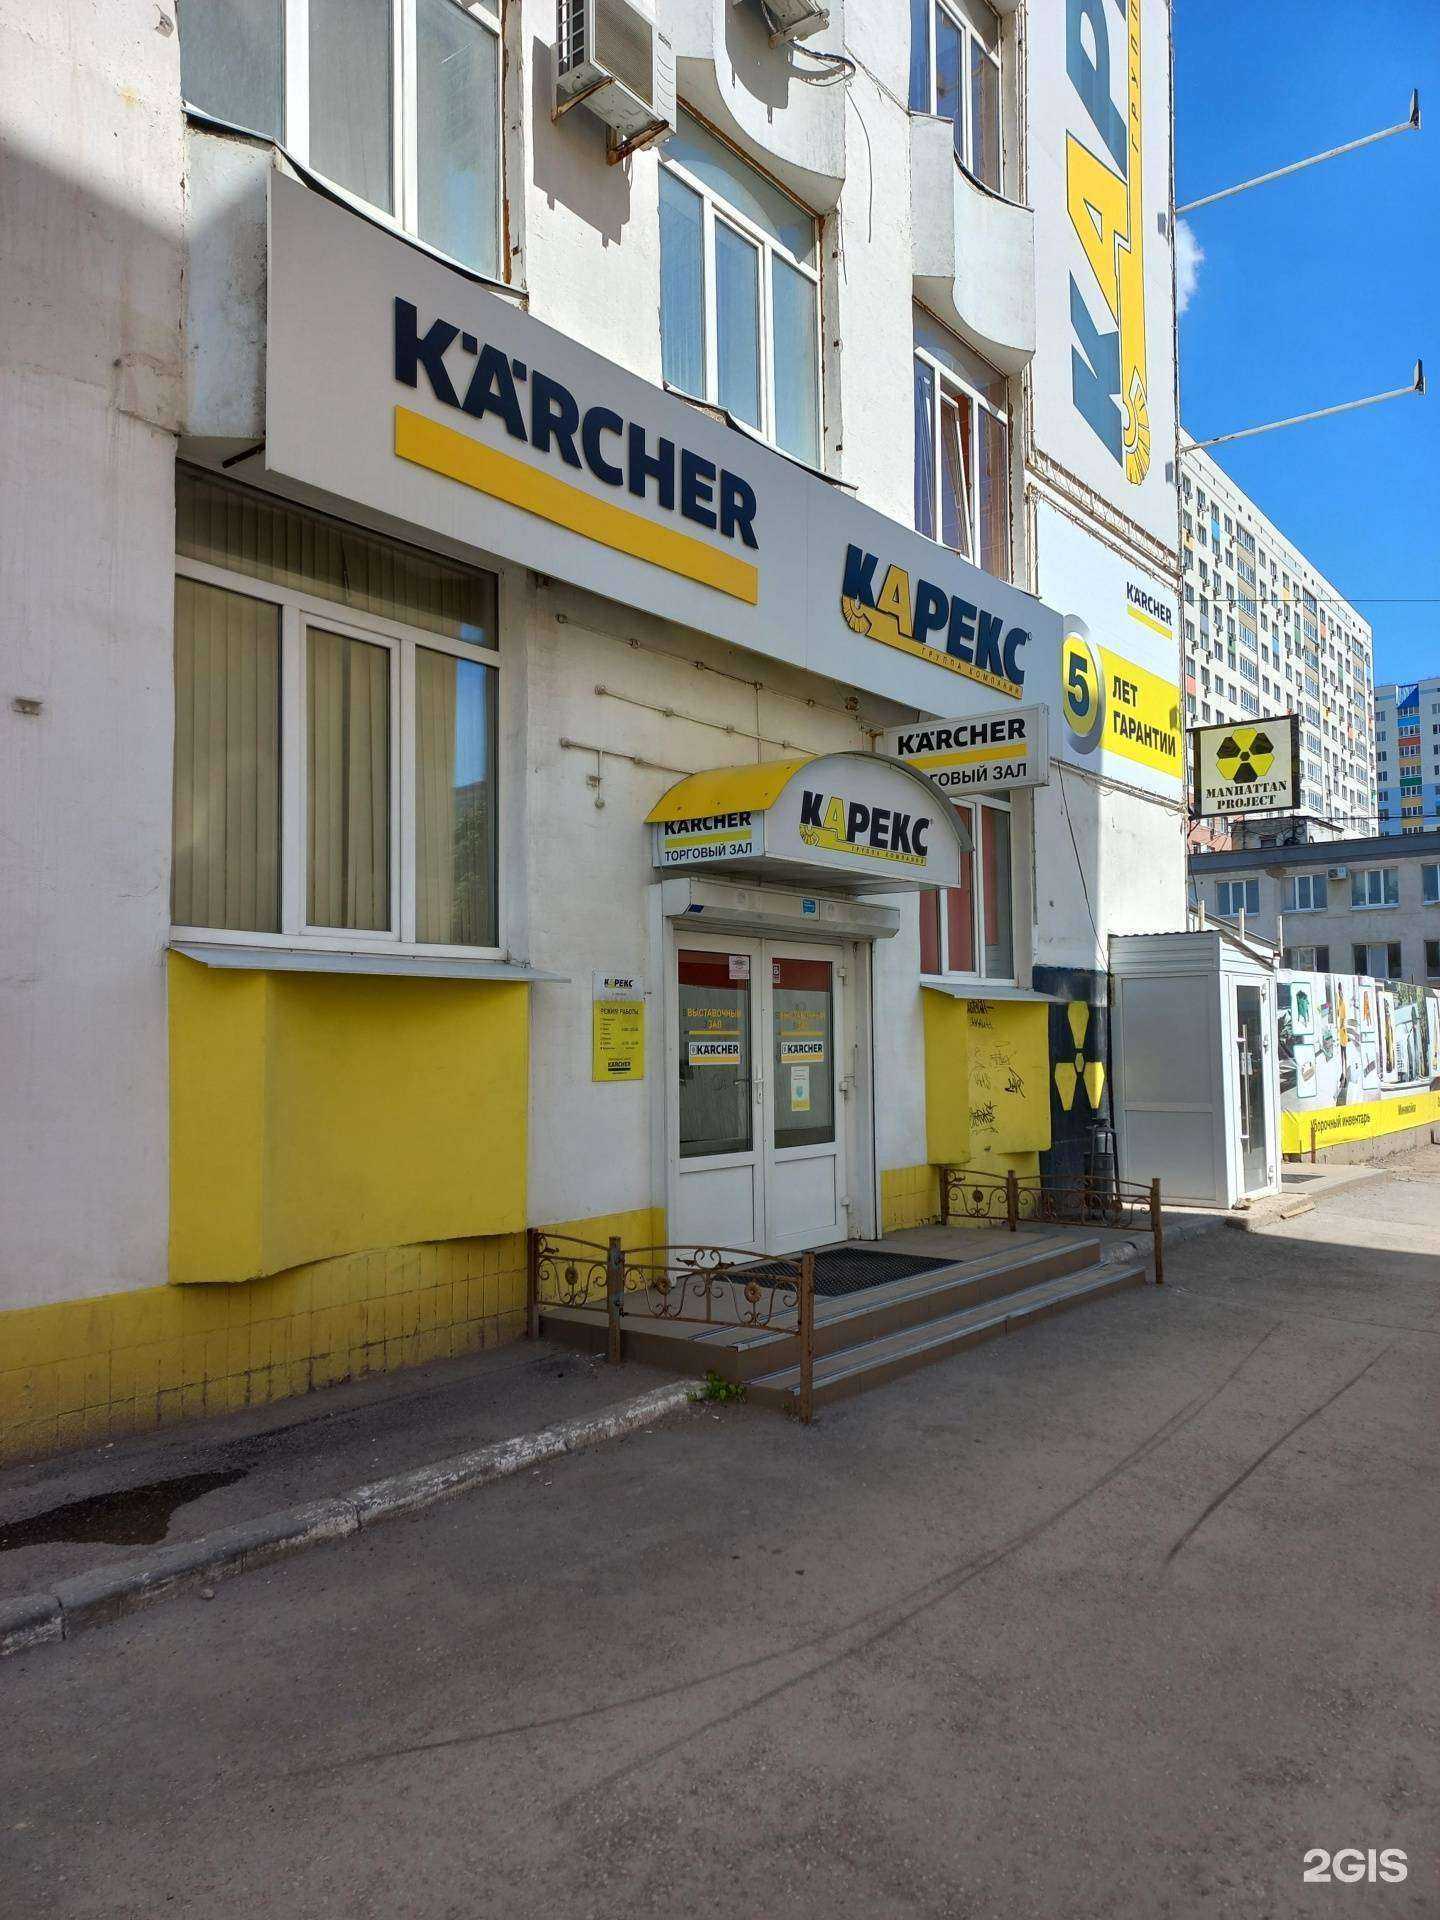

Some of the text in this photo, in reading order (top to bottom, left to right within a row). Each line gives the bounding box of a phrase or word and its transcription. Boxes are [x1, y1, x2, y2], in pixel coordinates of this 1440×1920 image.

[395, 297, 759, 550] KÄRCHER
[843, 543, 1028, 686] КАРЕКС
[1126, 581, 1172, 626] KÄRCHER
[1068, 652, 1138, 718] 5 ЛЕТ
[897, 718, 1027, 755] KÄRCHER
[1113, 711, 1176, 757] ГАРАНТИИ
[993, 763, 1027, 780] ЗАЛ
[1206, 780, 1287, 799] MANHATTAN
[800, 790, 930, 856] КАРЕКС
[1217, 794, 1276, 809] PROJECT
[665, 842, 753, 862] ТОРГОВЫЙ ЗАЛ
